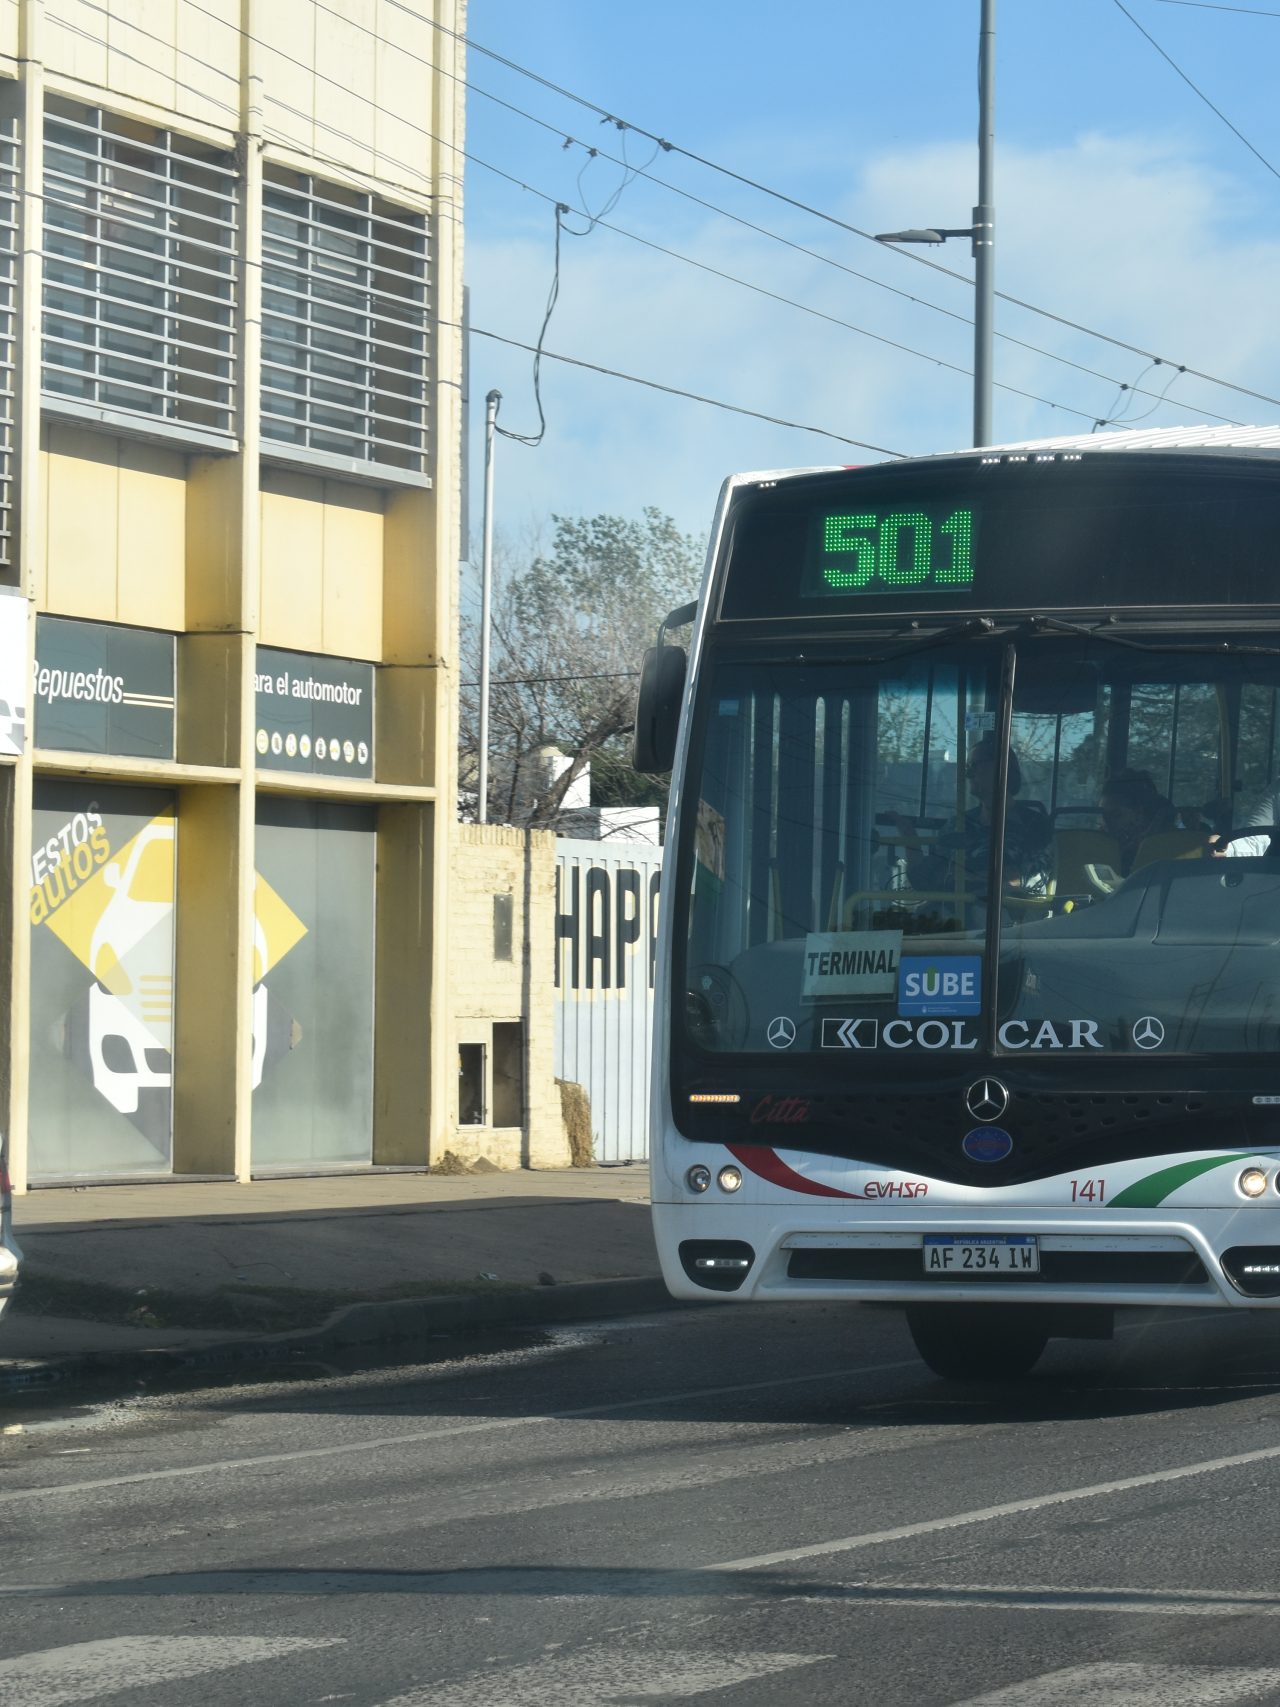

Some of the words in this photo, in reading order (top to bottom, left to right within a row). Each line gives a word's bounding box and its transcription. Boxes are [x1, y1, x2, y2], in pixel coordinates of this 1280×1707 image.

[824, 510, 975, 587] 501
[276, 672, 289, 696] el
[292, 677, 363, 706] automotor
[30, 825, 110, 926] autos
[807, 950, 897, 976] TERMINAL
[905, 970, 974, 996] SUBE
[882, 1020, 978, 1049] COL
[998, 1019, 1104, 1049] CAR
[864, 1181, 929, 1198] EVHSA
[1070, 1179, 1105, 1202] 141
[930, 1247, 954, 1268] AF
[961, 1247, 1000, 1268] 234
[1009, 1247, 1032, 1268] IW
